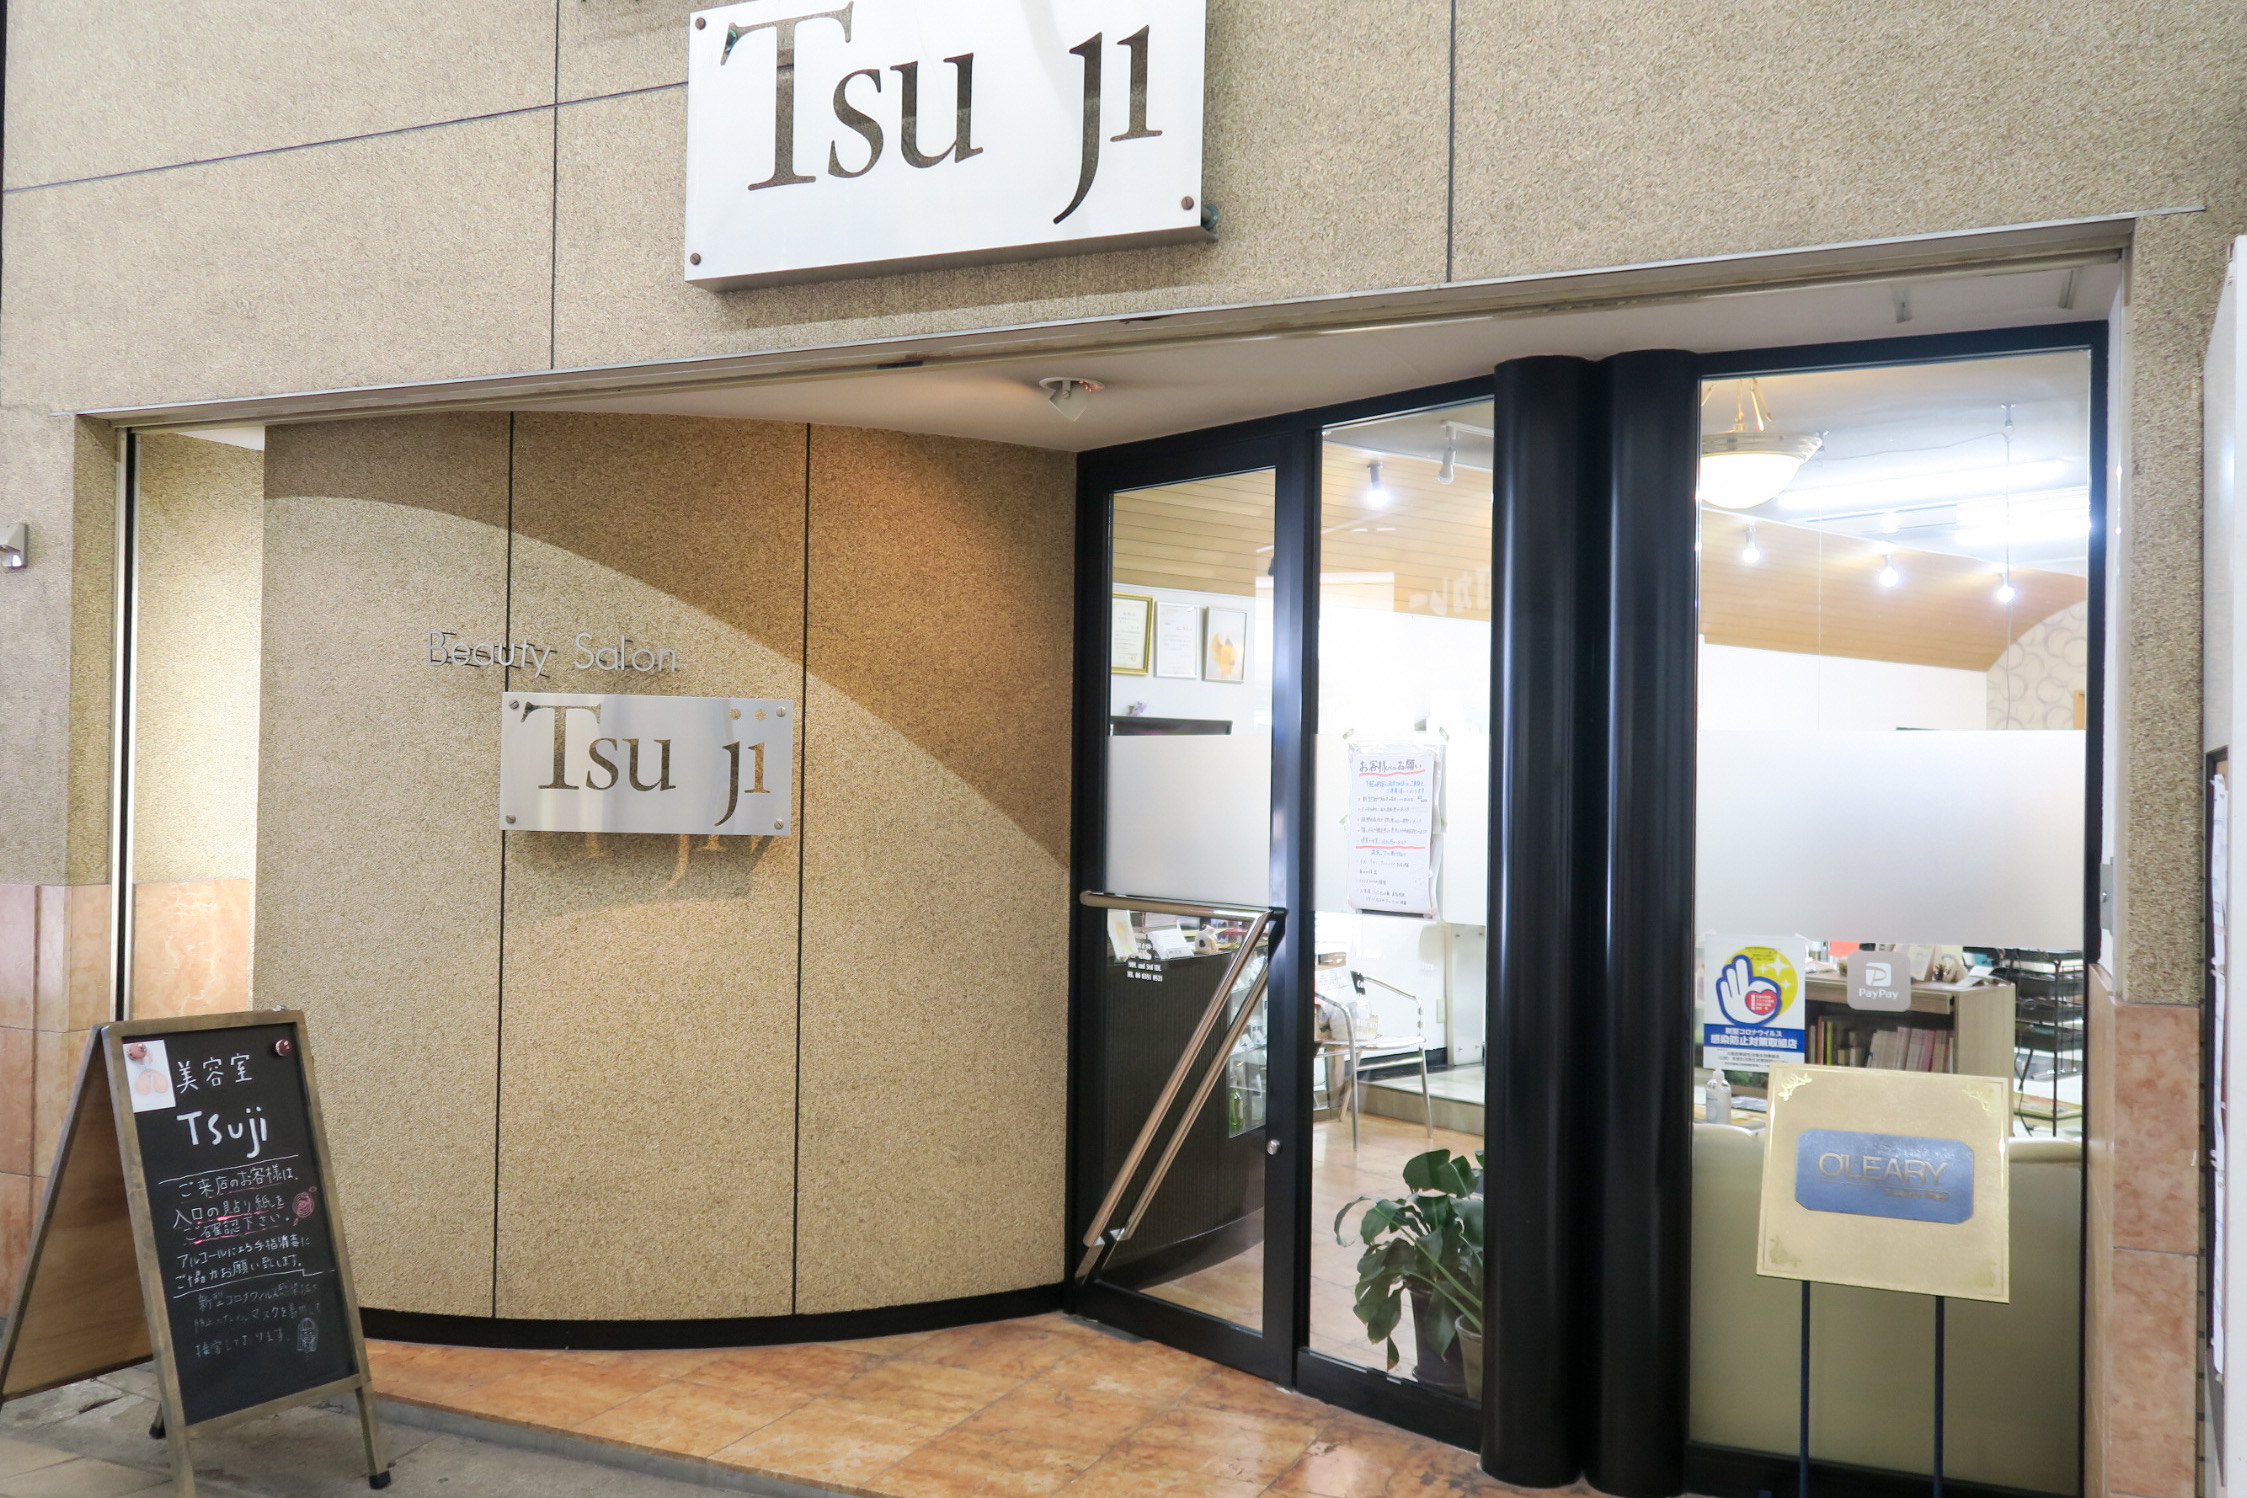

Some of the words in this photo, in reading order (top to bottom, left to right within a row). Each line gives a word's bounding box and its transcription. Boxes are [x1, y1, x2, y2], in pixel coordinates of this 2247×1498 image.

[427, 629, 552, 678] Beauty
[574, 631, 678, 673] Salon
[1858, 987, 1899, 1000] PayPay
[176, 1052, 253, 1094] 美容室
[176, 1106, 268, 1158] Tsuji
